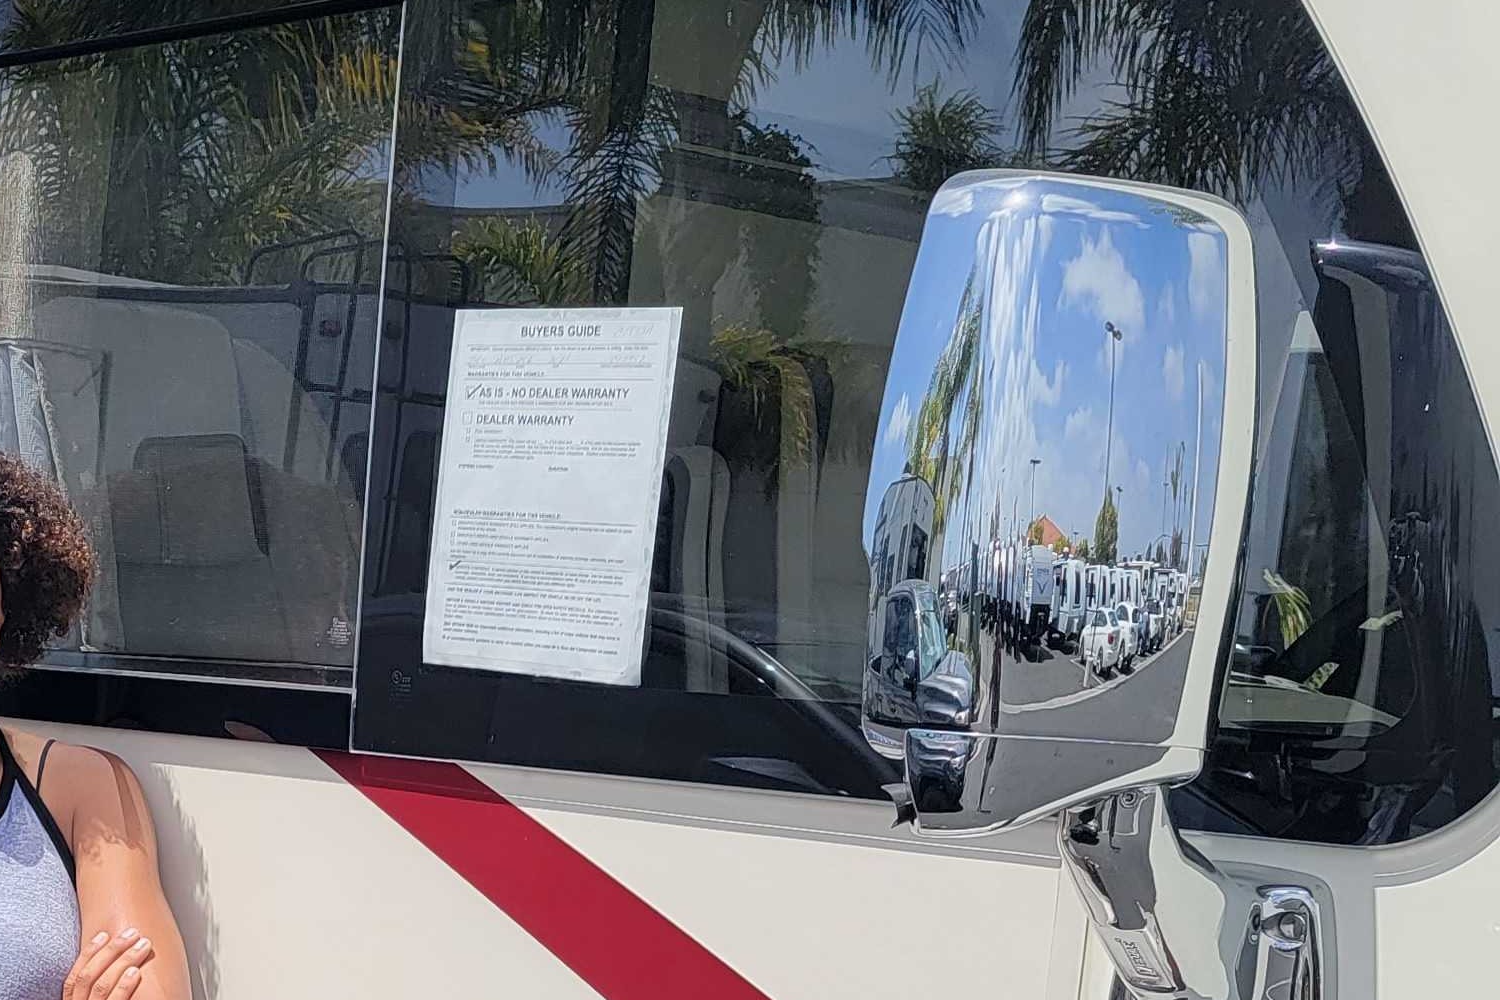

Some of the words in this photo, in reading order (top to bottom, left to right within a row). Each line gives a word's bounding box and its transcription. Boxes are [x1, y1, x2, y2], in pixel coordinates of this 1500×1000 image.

[521, 325, 564, 338] BUYERS
[568, 325, 601, 337] GUIDE
[478, 387, 492, 398] AS
[494, 387, 504, 398] IS
[511, 387, 527, 399] NO
[529, 387, 569, 399] DEALER
[571, 387, 630, 400] WARRANTY
[476, 414, 515, 425] DEALER
[517, 415, 575, 426] WARRANTY
